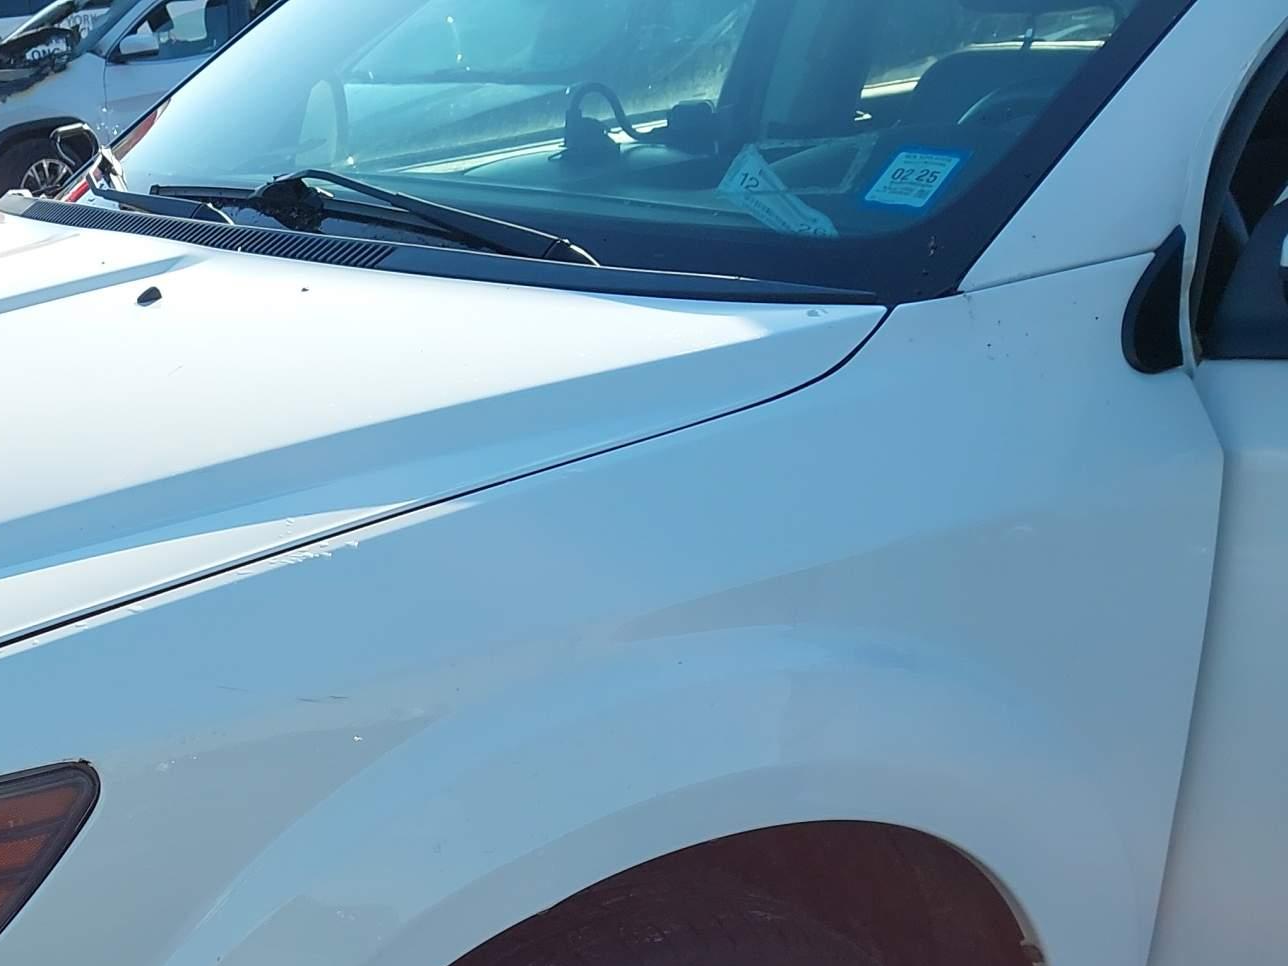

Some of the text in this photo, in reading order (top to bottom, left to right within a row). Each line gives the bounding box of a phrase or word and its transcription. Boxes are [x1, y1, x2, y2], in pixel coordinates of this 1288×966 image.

[739, 172, 759, 190] 12
[891, 167, 941, 184] 02 25
